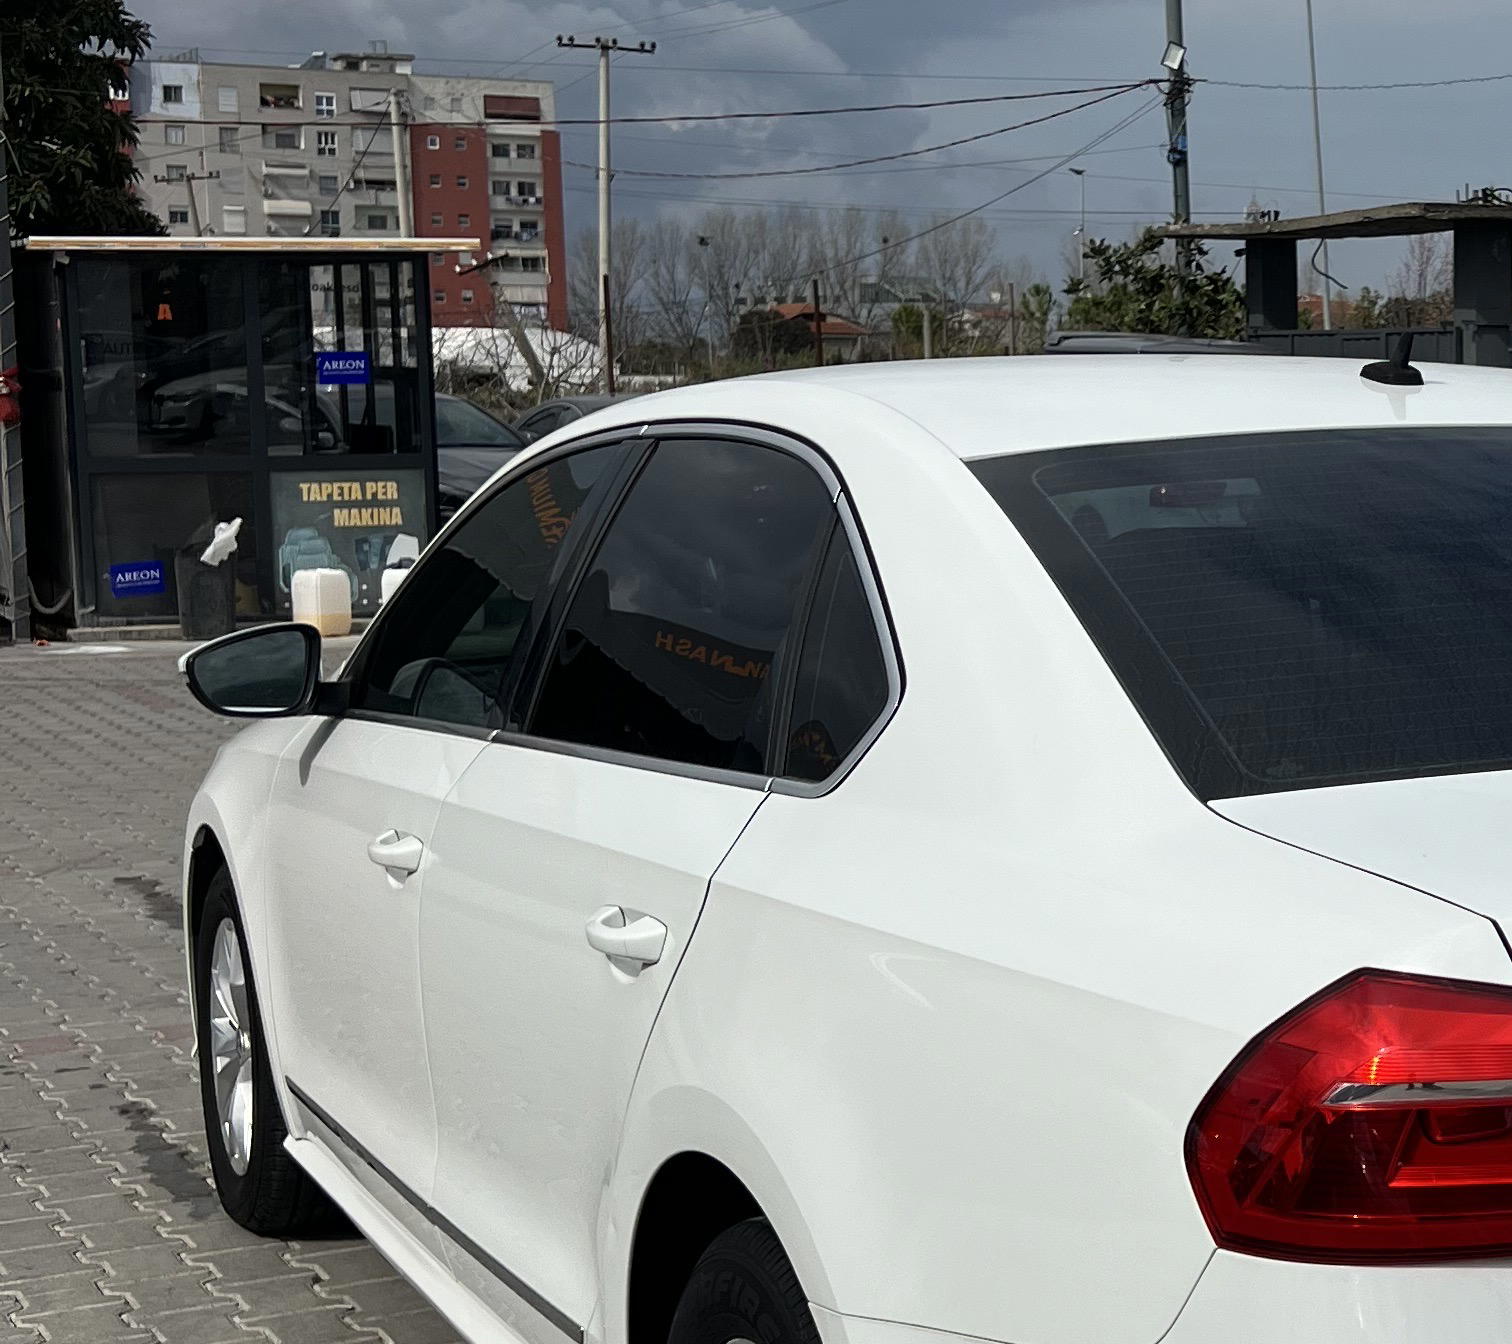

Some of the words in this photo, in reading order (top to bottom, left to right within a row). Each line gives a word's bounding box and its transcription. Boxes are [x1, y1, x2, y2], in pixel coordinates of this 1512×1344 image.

[323, 359, 365, 370] AREON
[298, 481, 363, 502] TAPETA
[365, 481, 399, 501] PER
[332, 507, 403, 528] MAKINA
[116, 568, 160, 583] AREON
